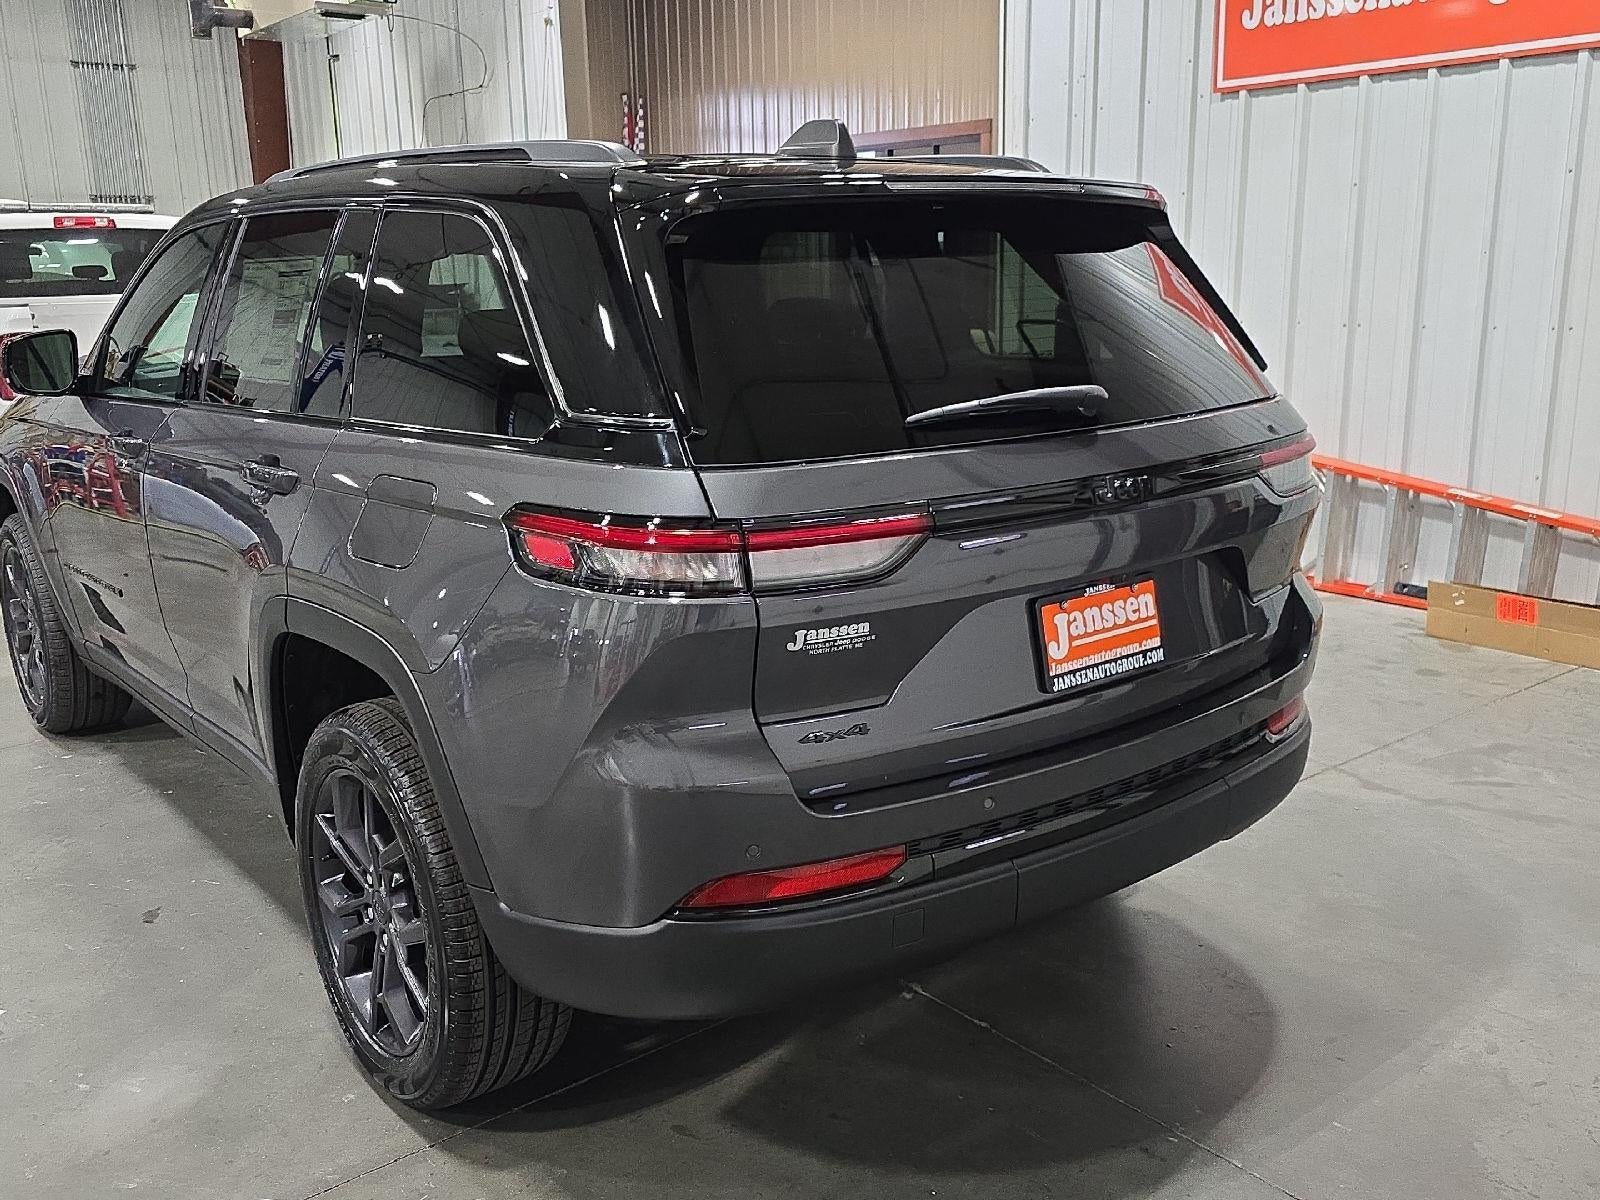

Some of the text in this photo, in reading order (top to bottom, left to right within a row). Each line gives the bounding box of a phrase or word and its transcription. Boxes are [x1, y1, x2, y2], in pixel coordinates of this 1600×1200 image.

[786, 621, 870, 651] Janssen
[1048, 592, 1157, 660] Janssen
[1053, 648, 1165, 692] JANSSENAUTOGROUP.COM
